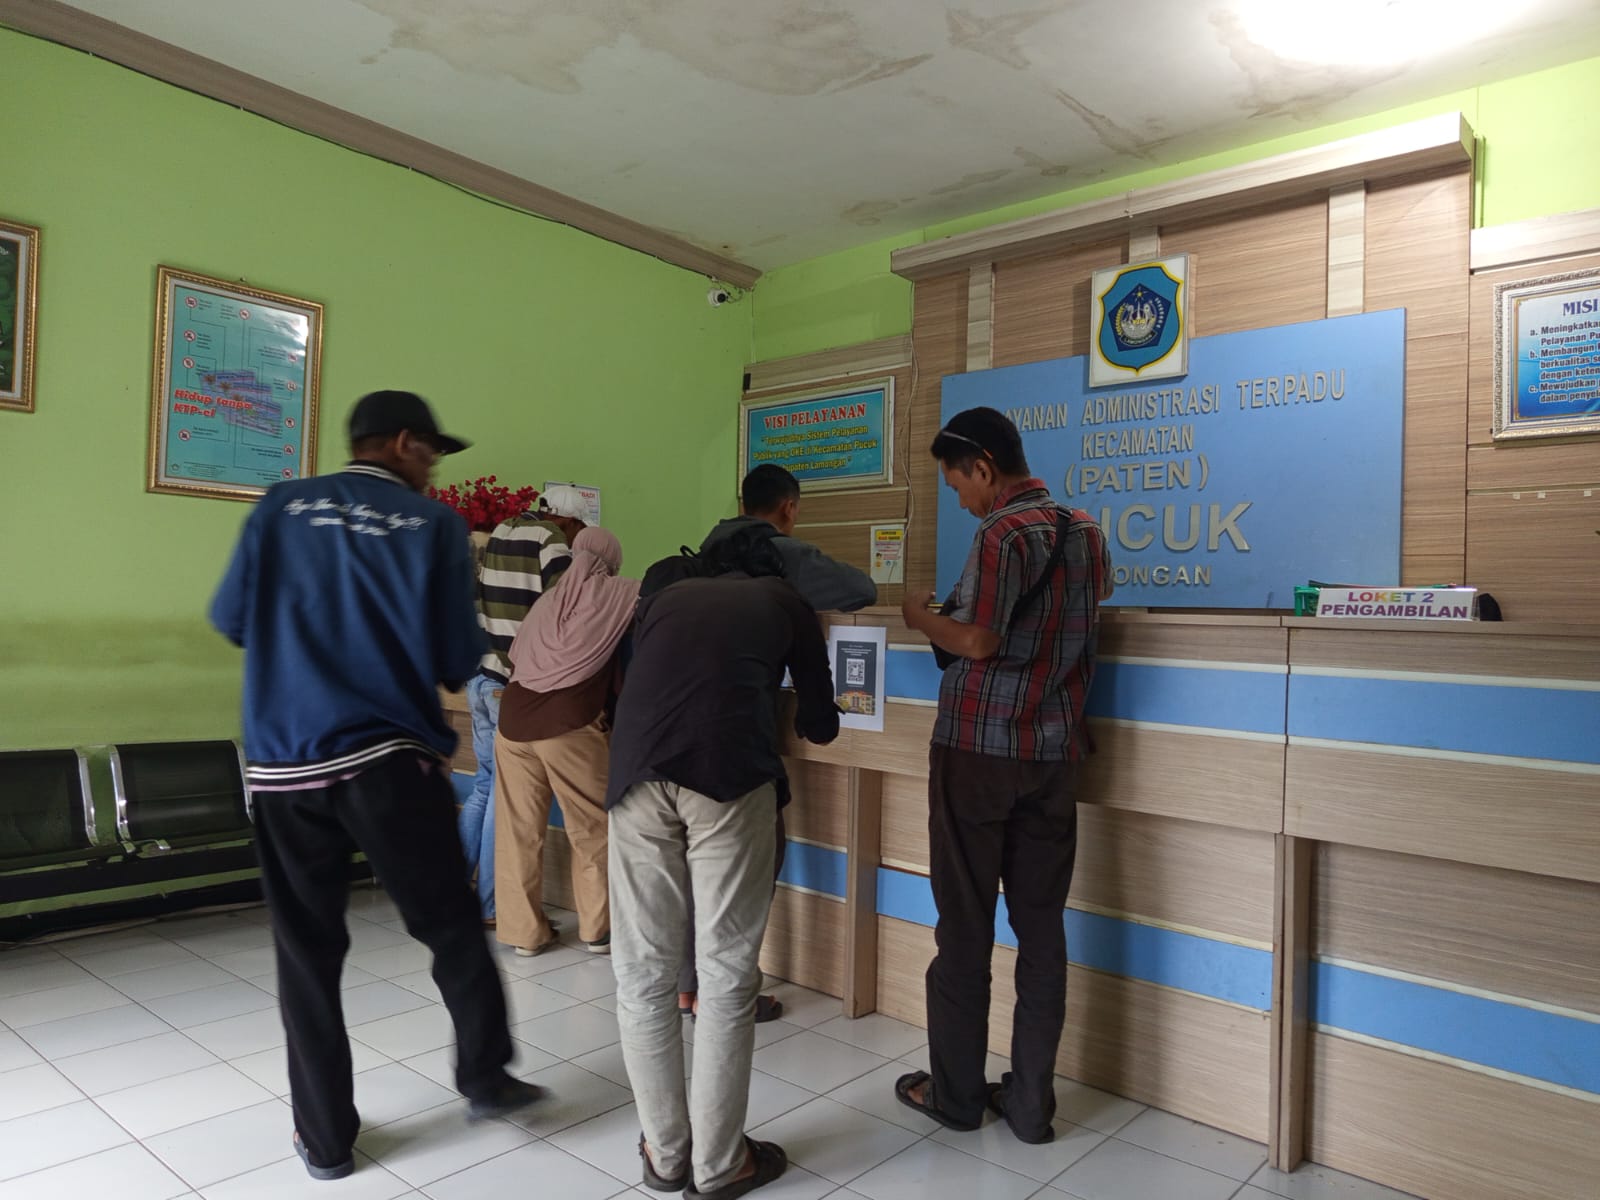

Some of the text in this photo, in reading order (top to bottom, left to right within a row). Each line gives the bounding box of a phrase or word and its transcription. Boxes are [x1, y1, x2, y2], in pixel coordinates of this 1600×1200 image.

[1562, 299, 1598, 316] MISI
[1541, 334, 1586, 346] Pelayanan
[1541, 344, 1594, 357] Membangun
[1541, 356, 1590, 369] berkualitas
[1541, 370, 1573, 380] dengan
[1541, 379, 1595, 391] Mewujudkan
[174, 389, 253, 411] Hidup tanpa
[1082, 384, 1220, 426] ADMINISTRASI
[1236, 368, 1345, 409] TERPADU
[1541, 393, 1567, 403] dalam
[173, 402, 216, 418] KTP-el
[764, 403, 867, 429] VISI PELAYANAN
[807, 430, 830, 440] Sistem
[831, 425, 868, 438] Pelayanan
[814, 443, 852, 454] Kecamatan
[854, 438, 877, 449] Pucuk
[1081, 424, 1194, 460] KECAMATAN
[1065, 454, 1210, 496] (PATEN)
[1348, 591, 1434, 603] LOKET 2
[1320, 604, 1468, 618] PENGAMBILAN
